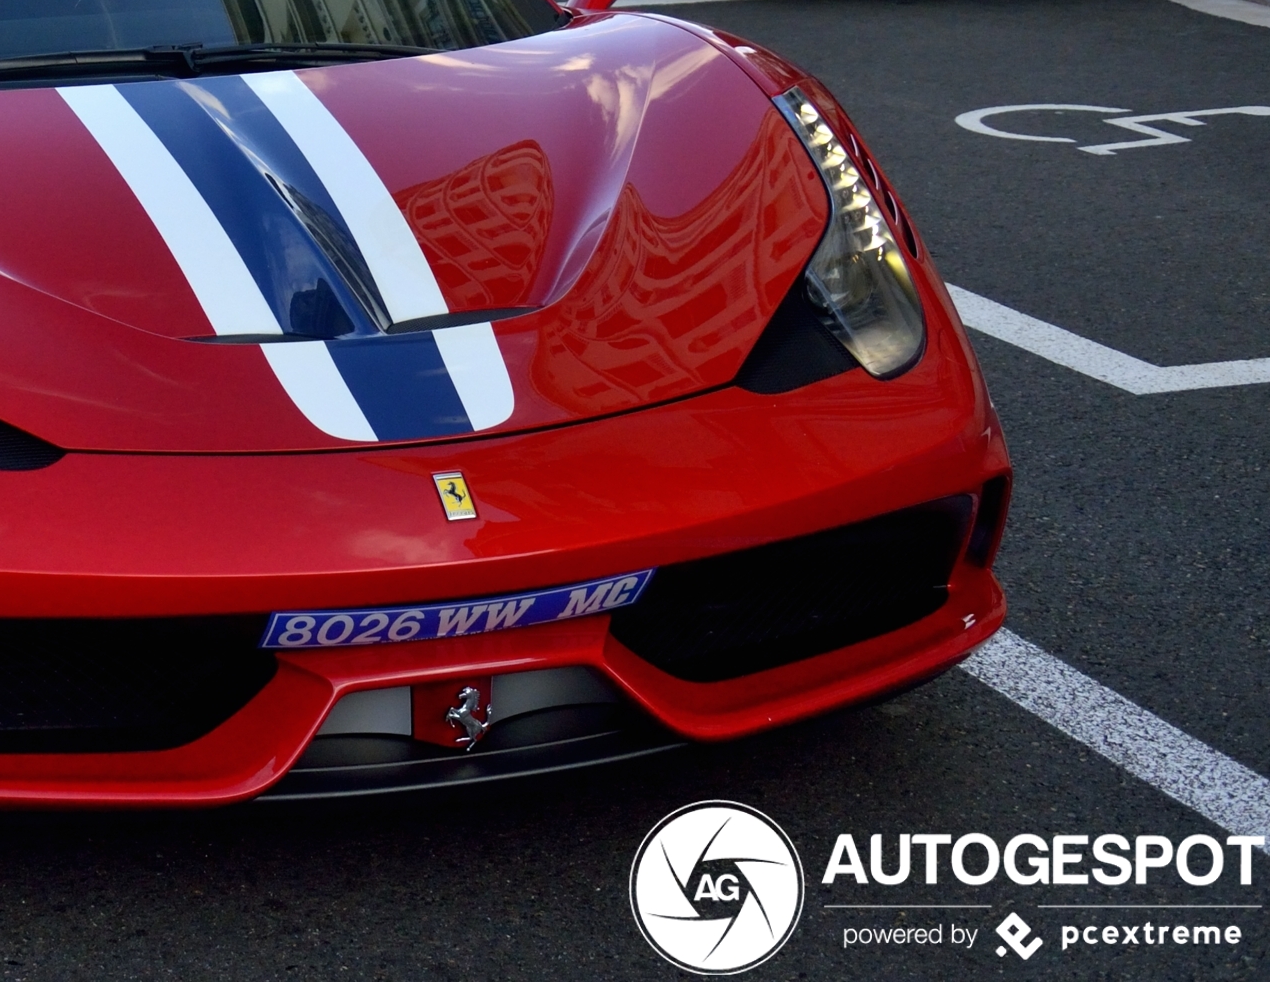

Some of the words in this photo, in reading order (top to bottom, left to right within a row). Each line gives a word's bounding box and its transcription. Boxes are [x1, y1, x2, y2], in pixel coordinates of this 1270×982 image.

[277, 610, 425, 647] 8026
[436, 597, 536, 637] WW
[558, 575, 638, 618] MC
